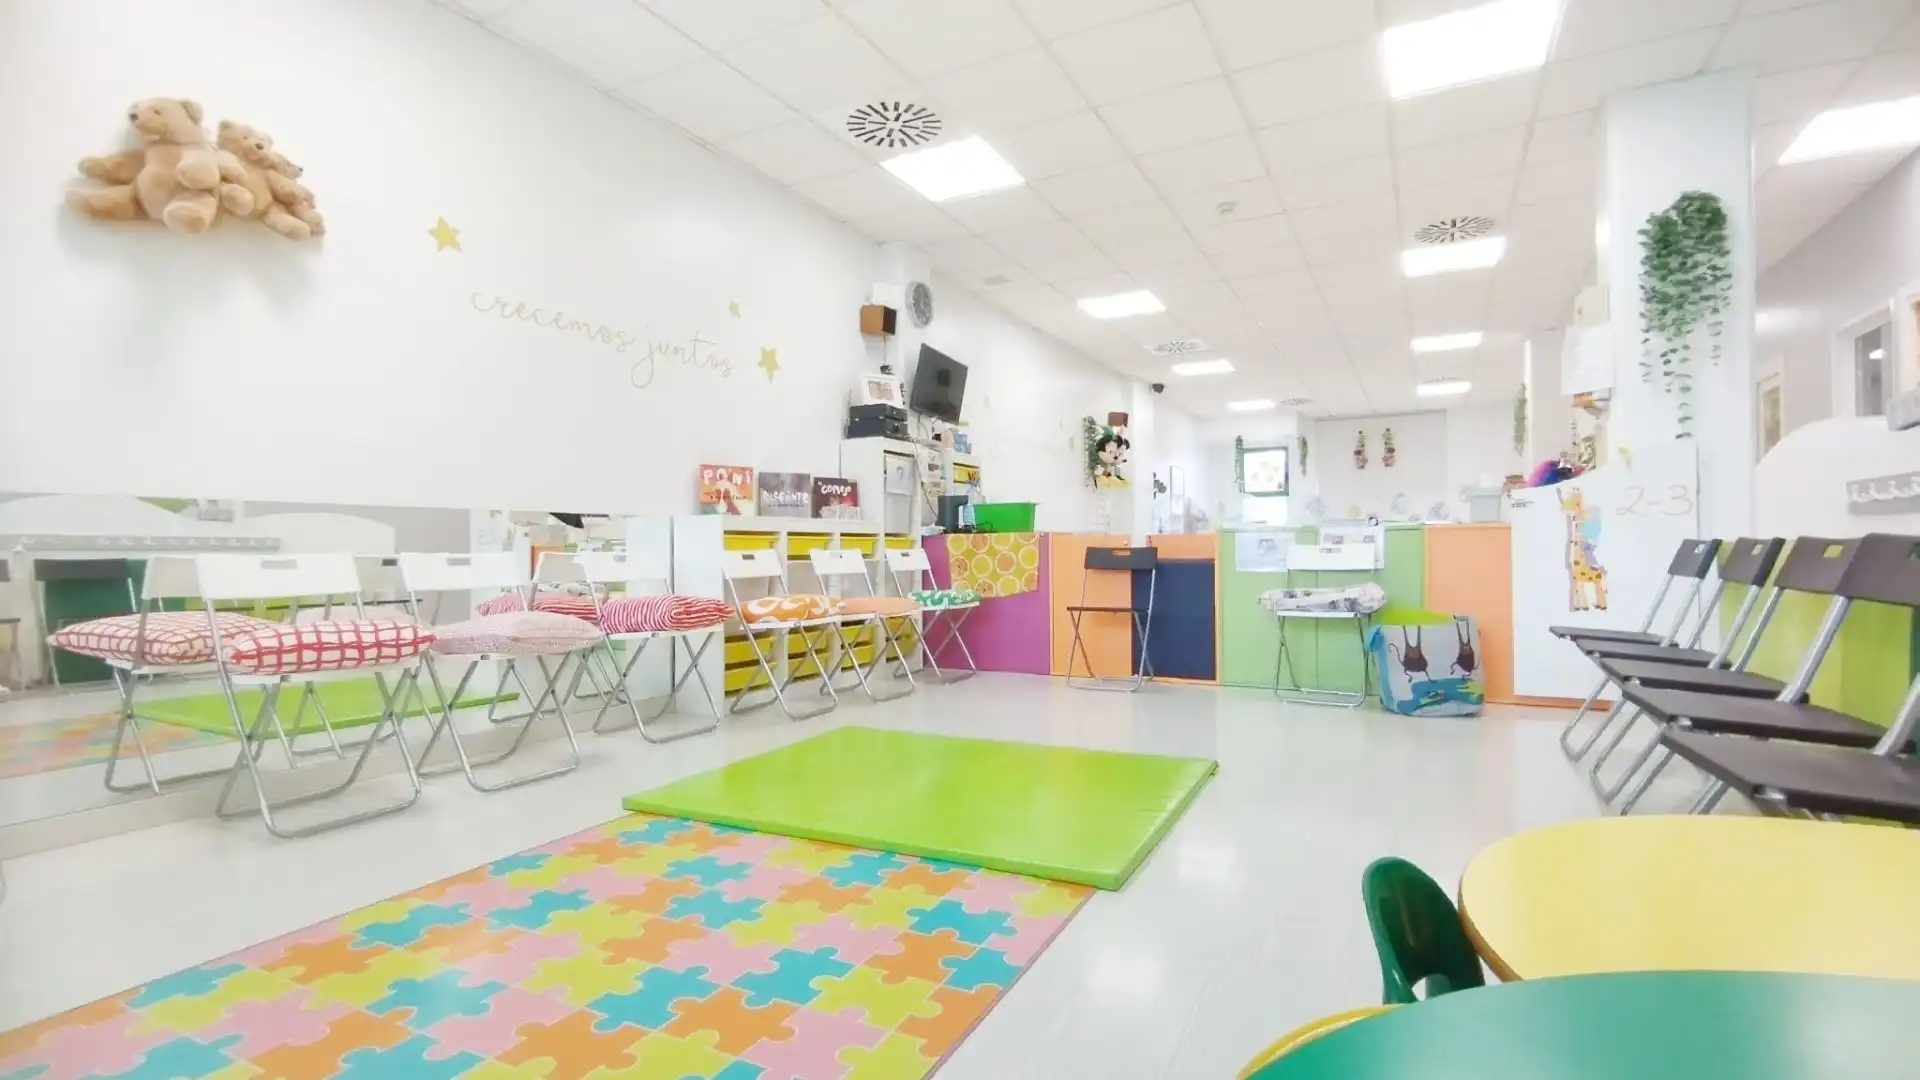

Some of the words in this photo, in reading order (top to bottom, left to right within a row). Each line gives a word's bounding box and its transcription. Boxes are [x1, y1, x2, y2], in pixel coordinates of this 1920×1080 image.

[470, 292, 635, 353] crecemos
[630, 323, 735, 389] juntos
[703, 468, 752, 486] PONI
[1615, 484, 1694, 517] 2-3
